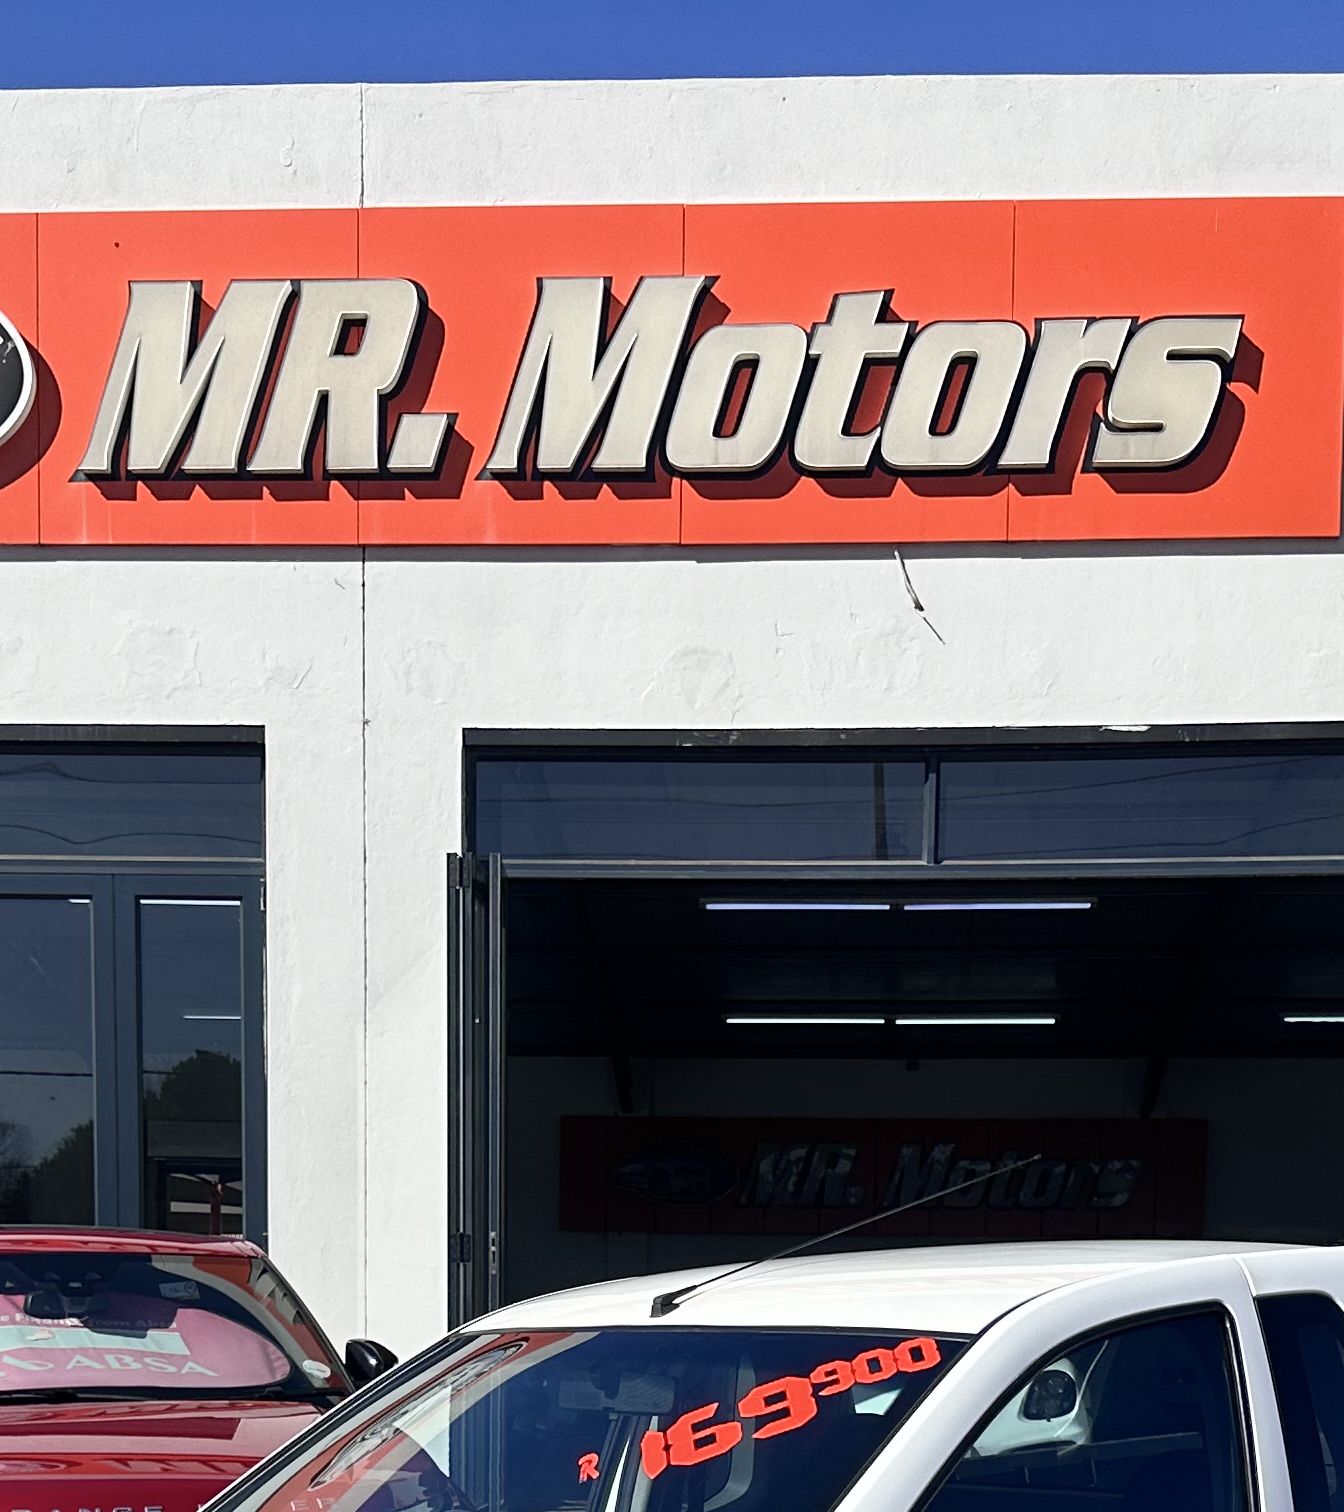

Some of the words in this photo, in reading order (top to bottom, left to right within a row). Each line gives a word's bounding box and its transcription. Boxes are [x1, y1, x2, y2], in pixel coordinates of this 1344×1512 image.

[69, 278, 458, 481] MR.
[477, 275, 1244, 478] Motors
[737, 1141, 865, 1209] MR.
[881, 1141, 1145, 1209] Motors
[65, 1355, 220, 1377] ABSA
[577, 1453, 600, 1483] R
